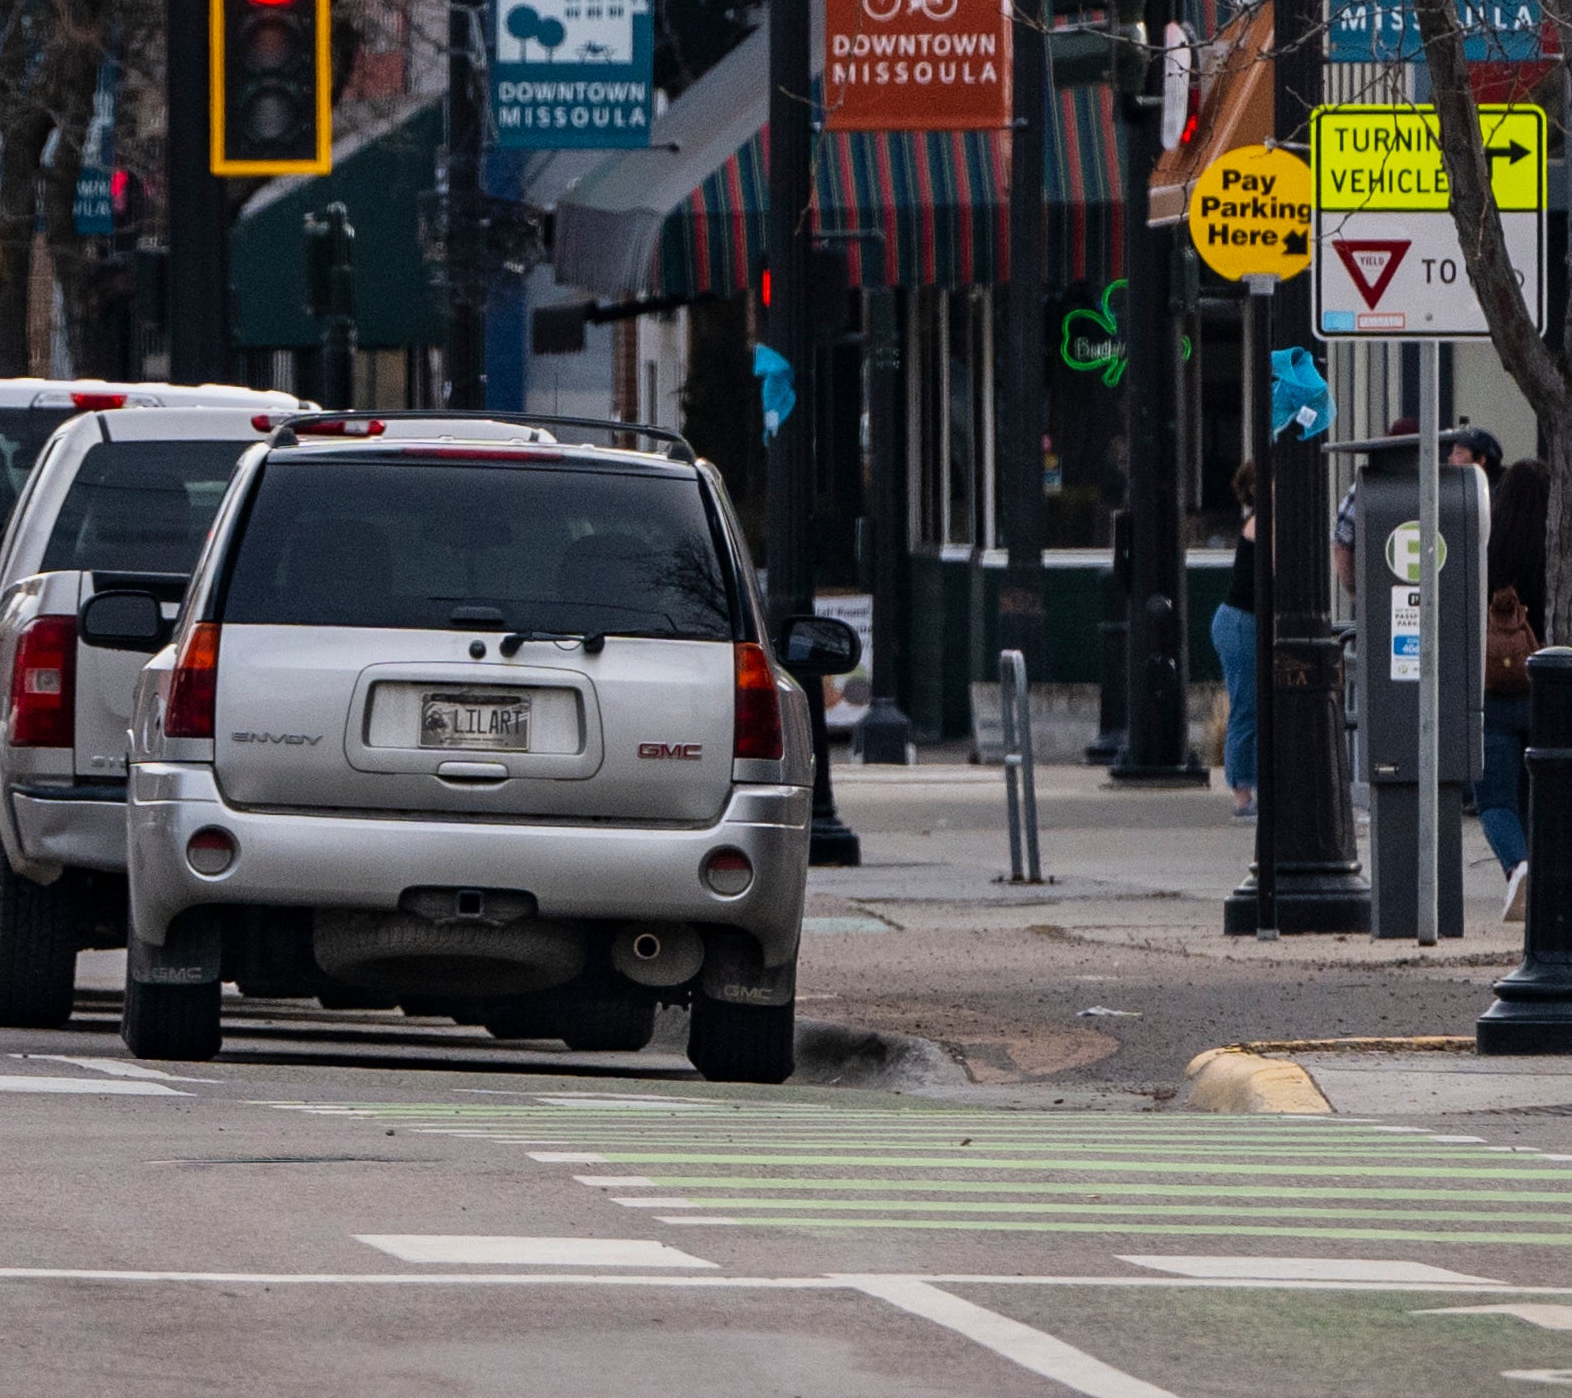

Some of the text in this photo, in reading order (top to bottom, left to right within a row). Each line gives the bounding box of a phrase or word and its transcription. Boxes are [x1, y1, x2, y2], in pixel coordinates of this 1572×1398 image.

[833, 33, 997, 57] DOWNTOWN
[832, 61, 998, 85] MISSOULA
[497, 80, 646, 104] DOWNTOWN
[497, 105, 646, 128] MISSOULA
[1334, 127, 1442, 153] TURNIN
[1222, 169, 1276, 193] Pay
[1330, 168, 1450, 194] VEHICLE
[1201, 196, 1311, 223] Parking
[1208, 224, 1278, 246] Here
[1420, 258, 1458, 285] TO
[454, 708, 522, 734] LILART
[232, 732, 324, 745] ENVOY
[638, 740, 703, 760] GMC
[152, 967, 202, 981] GMC
[723, 985, 775, 1001] GMC
